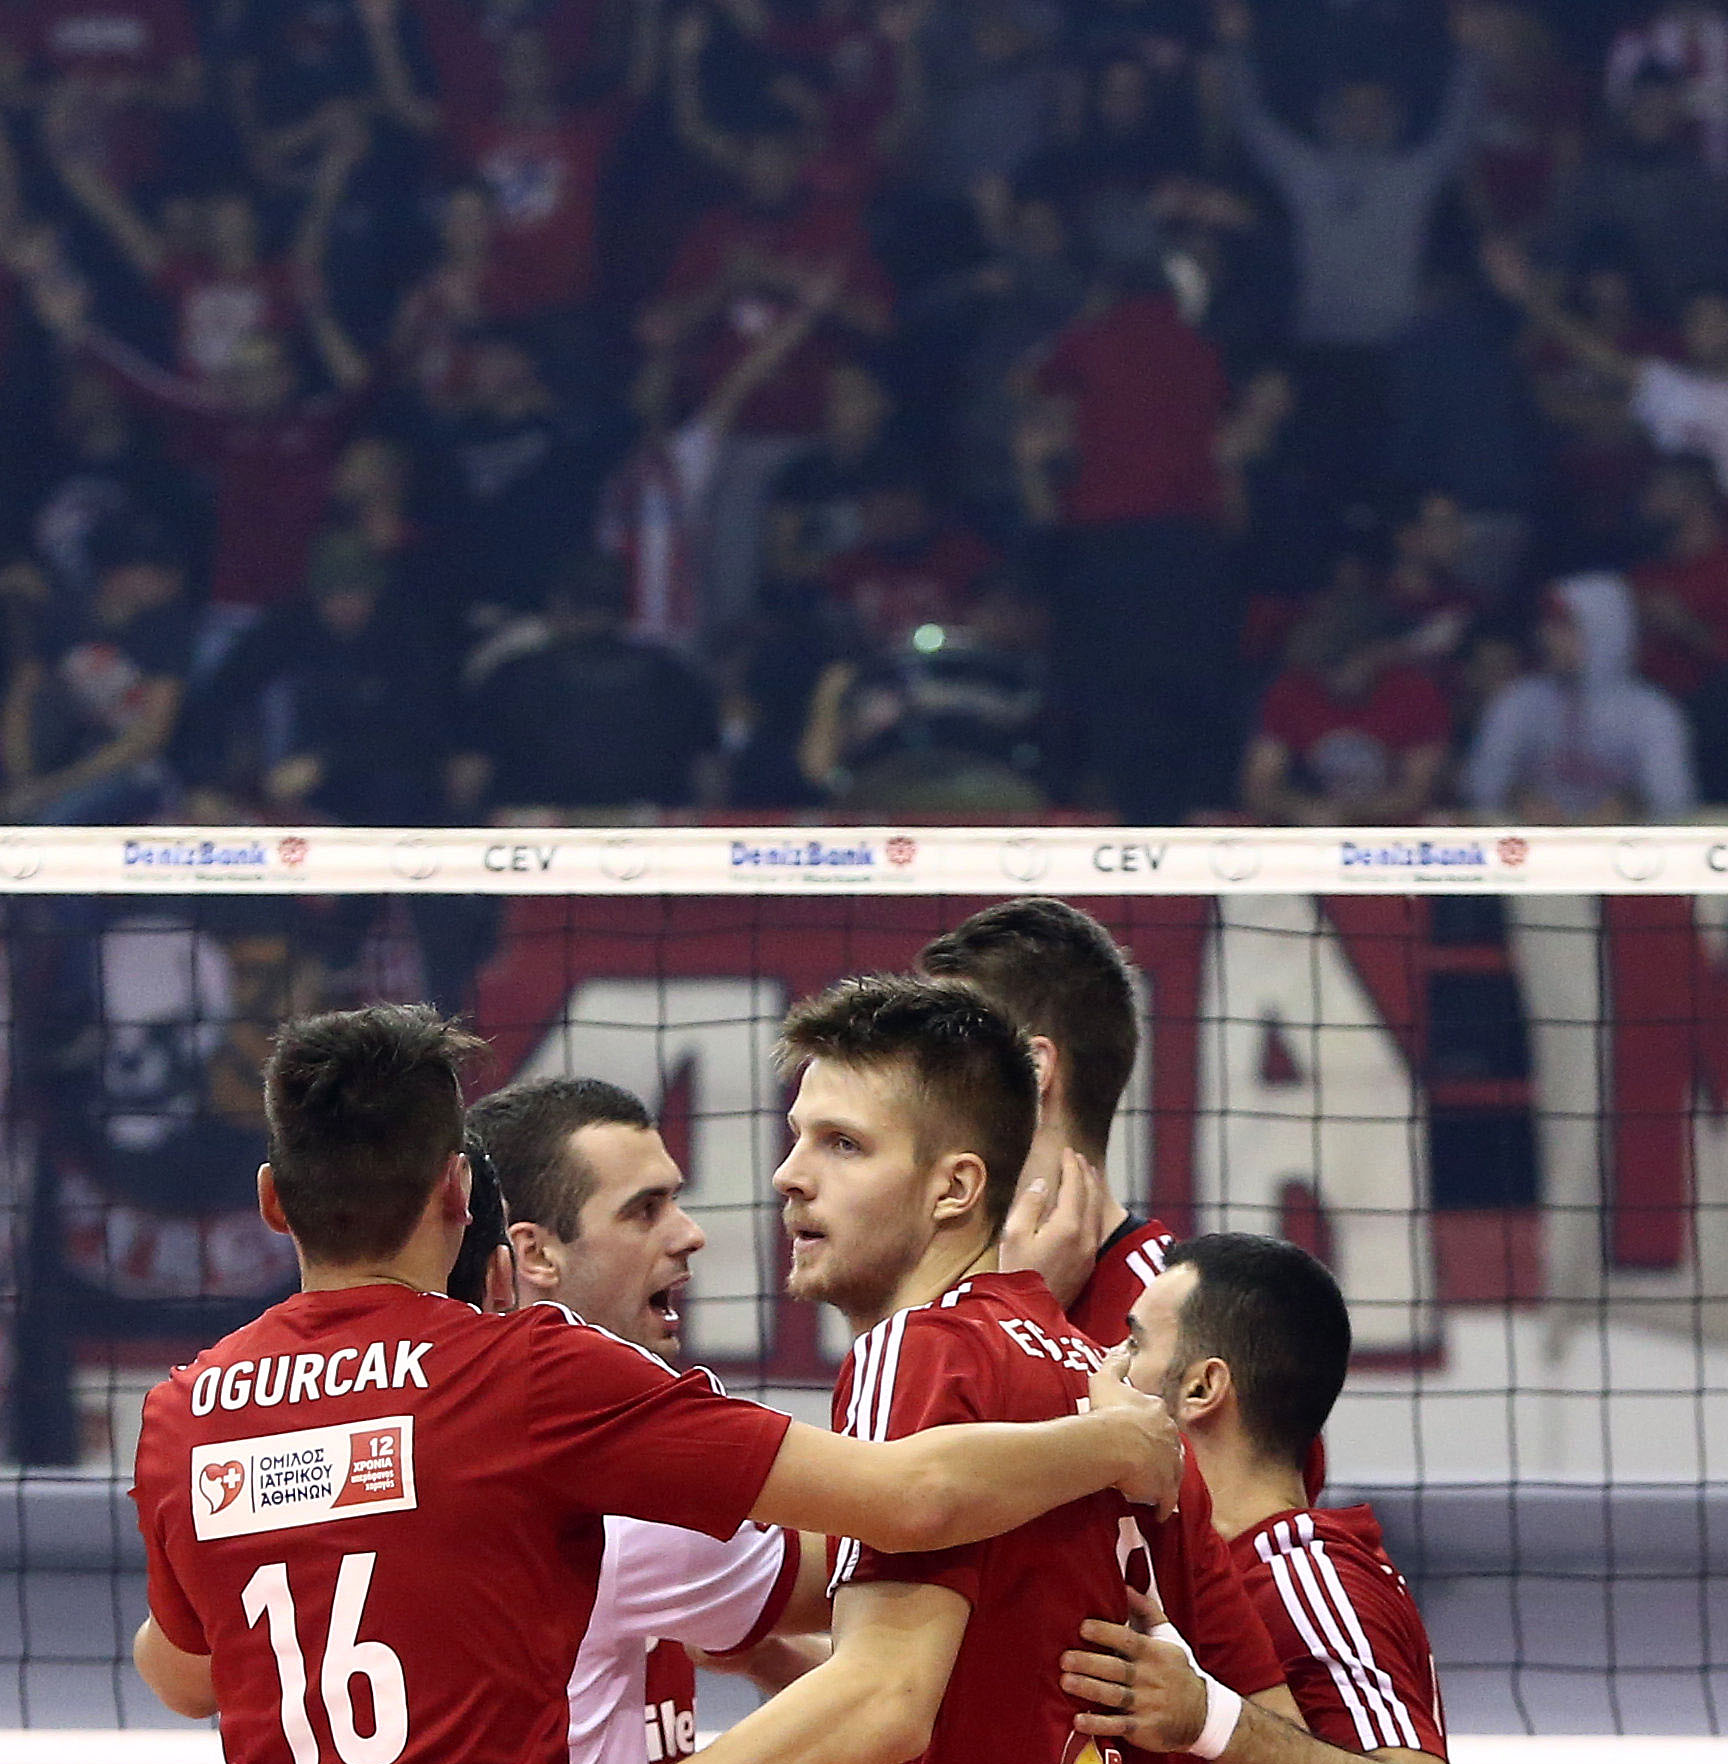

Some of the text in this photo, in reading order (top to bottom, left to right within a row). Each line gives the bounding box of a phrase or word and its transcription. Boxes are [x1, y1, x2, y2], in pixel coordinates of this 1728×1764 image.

[124, 841, 267, 868] DenizBank
[483, 846, 558, 873] CEV
[731, 841, 874, 868] DenizBank
[1092, 845, 1166, 873] CEV
[1340, 842, 1486, 869] DenizBank
[191, 1340, 433, 1417] OGURCAK
[259, 1448, 325, 1471] ΟΜΙΛΟΣ
[369, 1435, 395, 1457] 12
[259, 1464, 334, 1490] ΙΑΤΡΙΚΟΥ
[260, 1482, 332, 1508] ΑΘΗΝΩΝ
